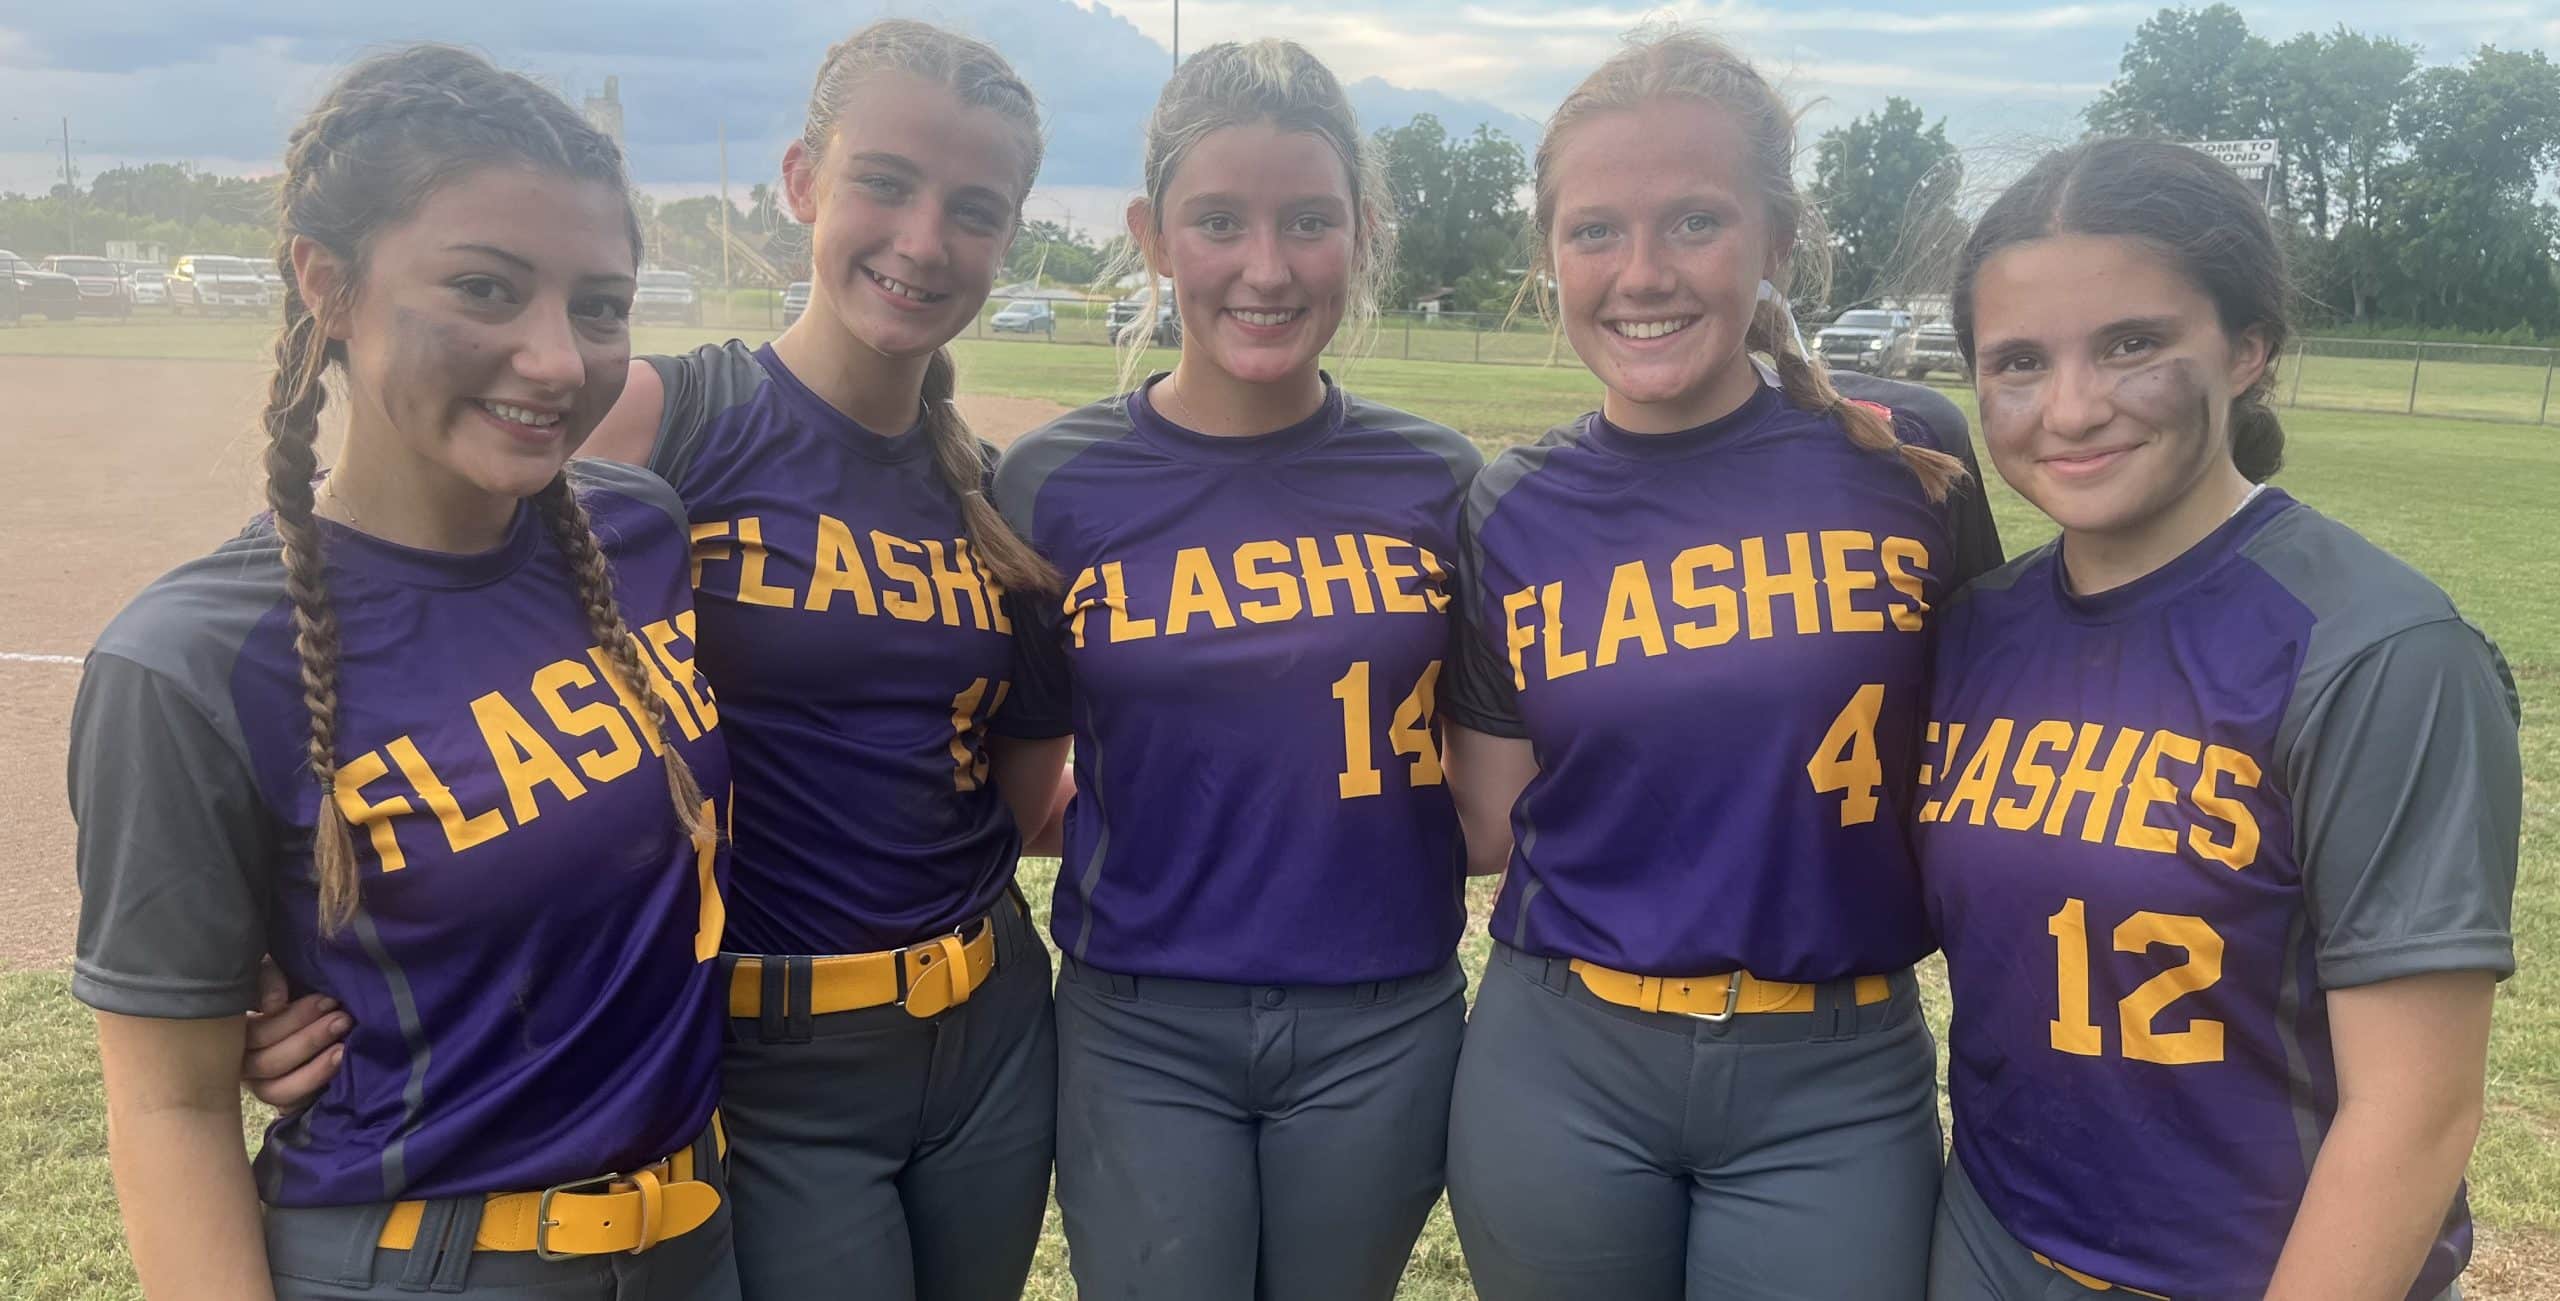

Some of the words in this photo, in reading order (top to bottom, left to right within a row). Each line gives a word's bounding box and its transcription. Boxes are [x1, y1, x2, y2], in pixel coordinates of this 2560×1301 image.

[2249, 142, 2272, 151] TO
[1503, 530, 1930, 692] FLASHES
[1331, 660, 1443, 800] 14
[1806, 684, 1885, 827] 4
[2048, 897, 2225, 1064] 12
